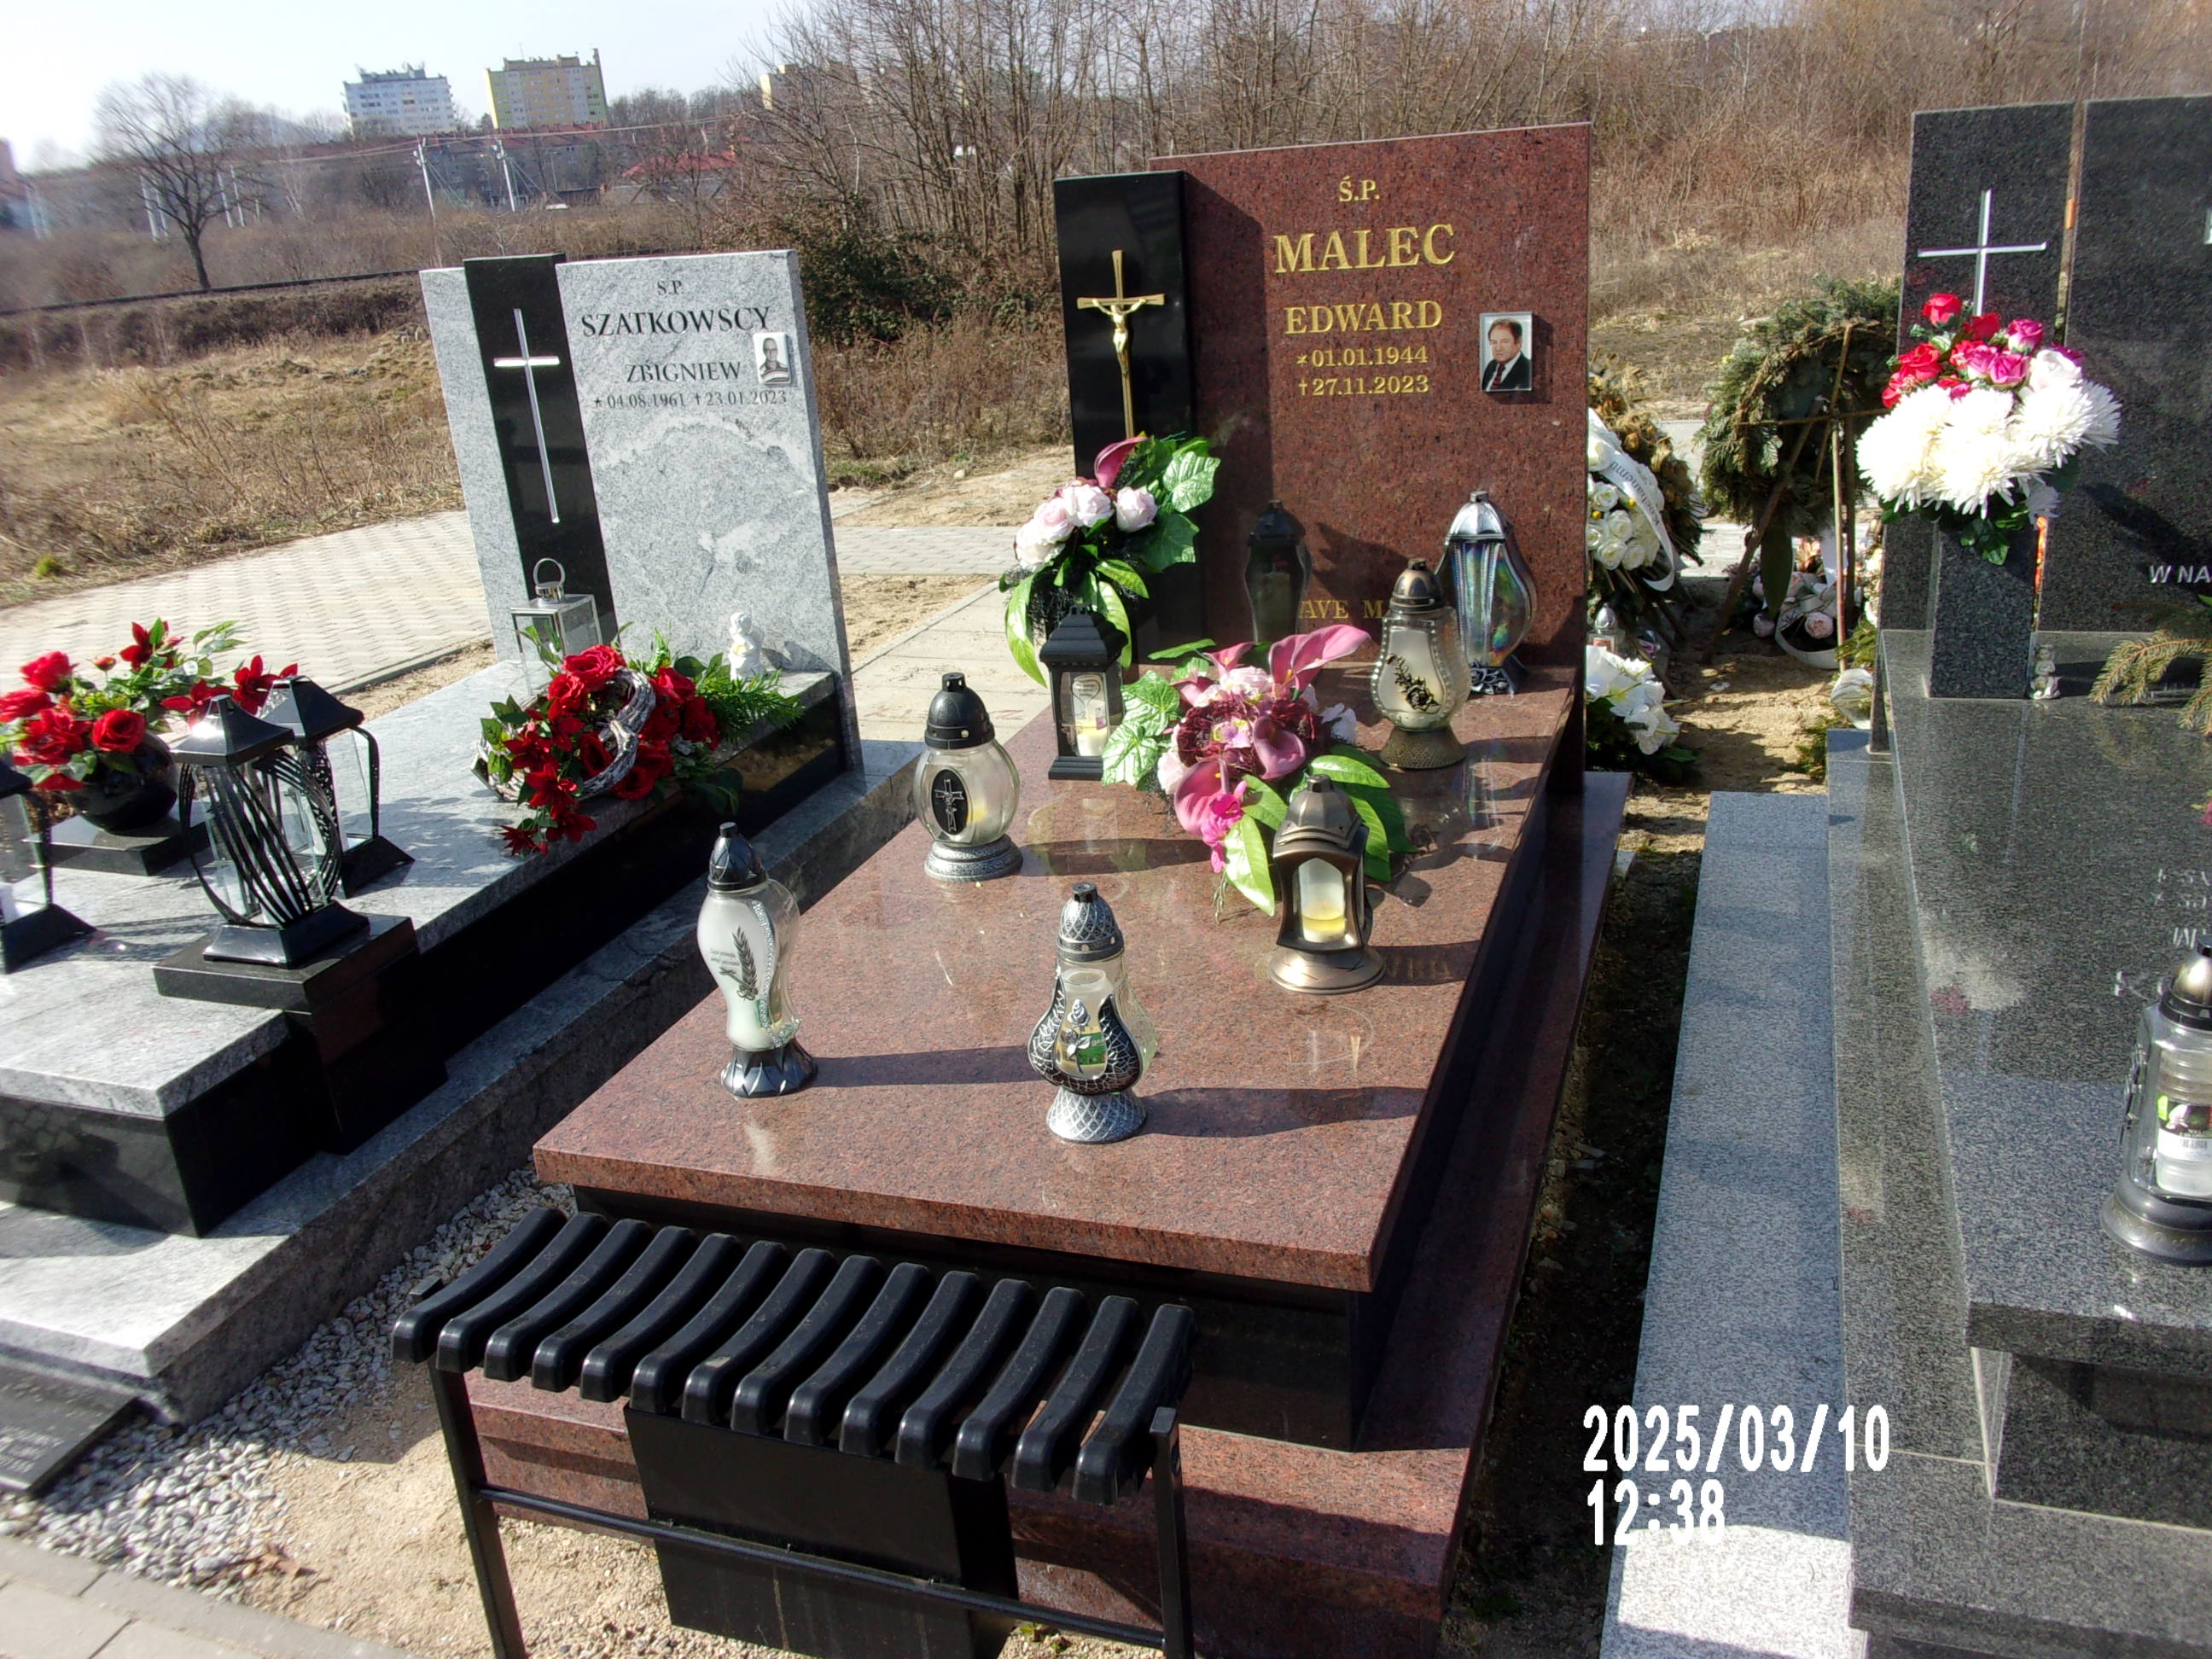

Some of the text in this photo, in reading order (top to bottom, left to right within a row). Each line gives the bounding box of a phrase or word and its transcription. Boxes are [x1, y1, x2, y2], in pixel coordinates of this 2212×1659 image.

[1338, 176, 1381, 202] Ś.P.
[1273, 224, 1456, 274] MALEC
[581, 306, 771, 337] SZATKOWSCY
[1283, 300, 1443, 335] EDWARD
[625, 362, 742, 383] ZBIGNIEW
[2148, 564, 2172, 584] W
[1299, 599, 1350, 620] AVE
